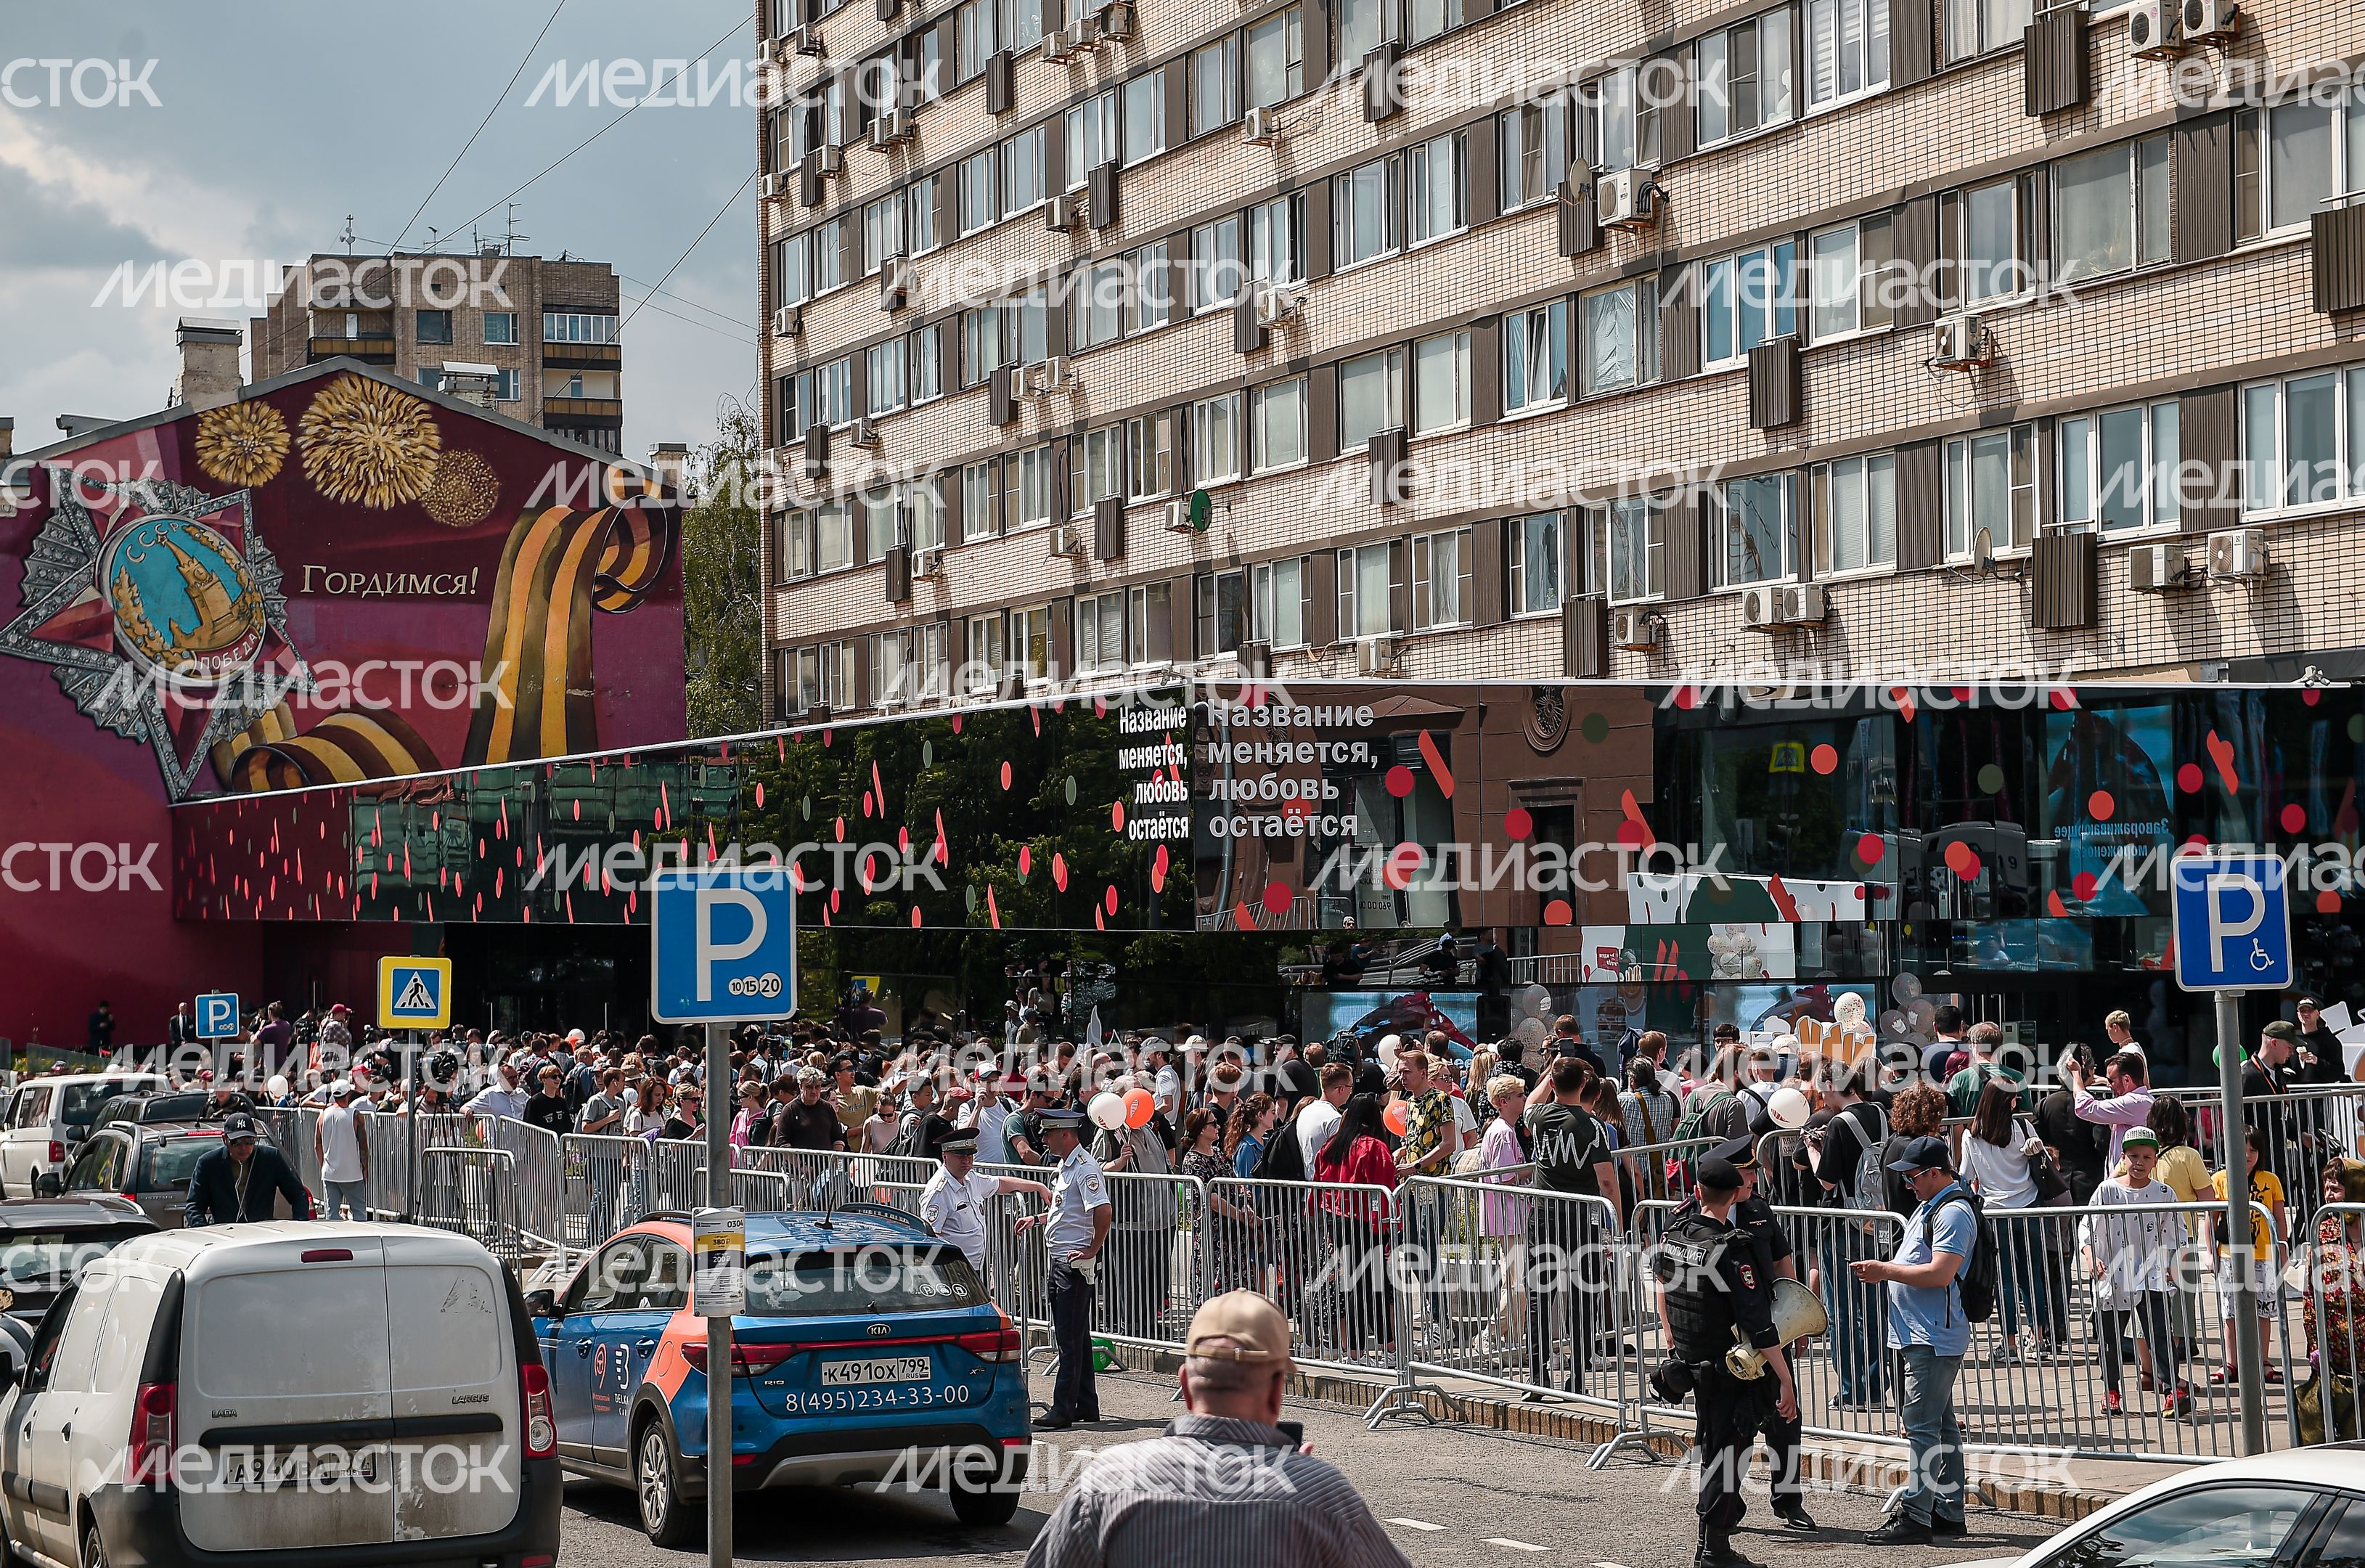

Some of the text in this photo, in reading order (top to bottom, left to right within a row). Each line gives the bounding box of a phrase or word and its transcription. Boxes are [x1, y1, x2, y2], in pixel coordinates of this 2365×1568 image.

[126, 522, 179, 563] СССР
[300, 565, 479, 598] Гордимся!
[200, 633, 258, 669] ПОБЕДА
[1119, 706, 1187, 734] Название
[1207, 698, 1374, 727] Название
[1119, 743, 1188, 770] меняется,
[1208, 741, 1378, 769] меняется,
[1135, 775, 1188, 804] любовь
[1209, 772, 1339, 801] любовь
[1128, 811, 1189, 841] остаётся
[1209, 807, 1358, 838] остаётся
[2207, 873, 2266, 972] P
[696, 888, 767, 1002] P
[732, 979, 780, 992] 10 15 20
[209, 1000, 230, 1032] P
[1665, 1244, 1702, 1261] ПОЛИЦИЯ
[870, 1326, 887, 1335] KIA
[899, 1358, 925, 1373] 799
[211, 1408, 238, 1418] LADA
[452, 1393, 489, 1405] LARGUS
[785, 1384, 968, 1414] 8(495)234-33-00
